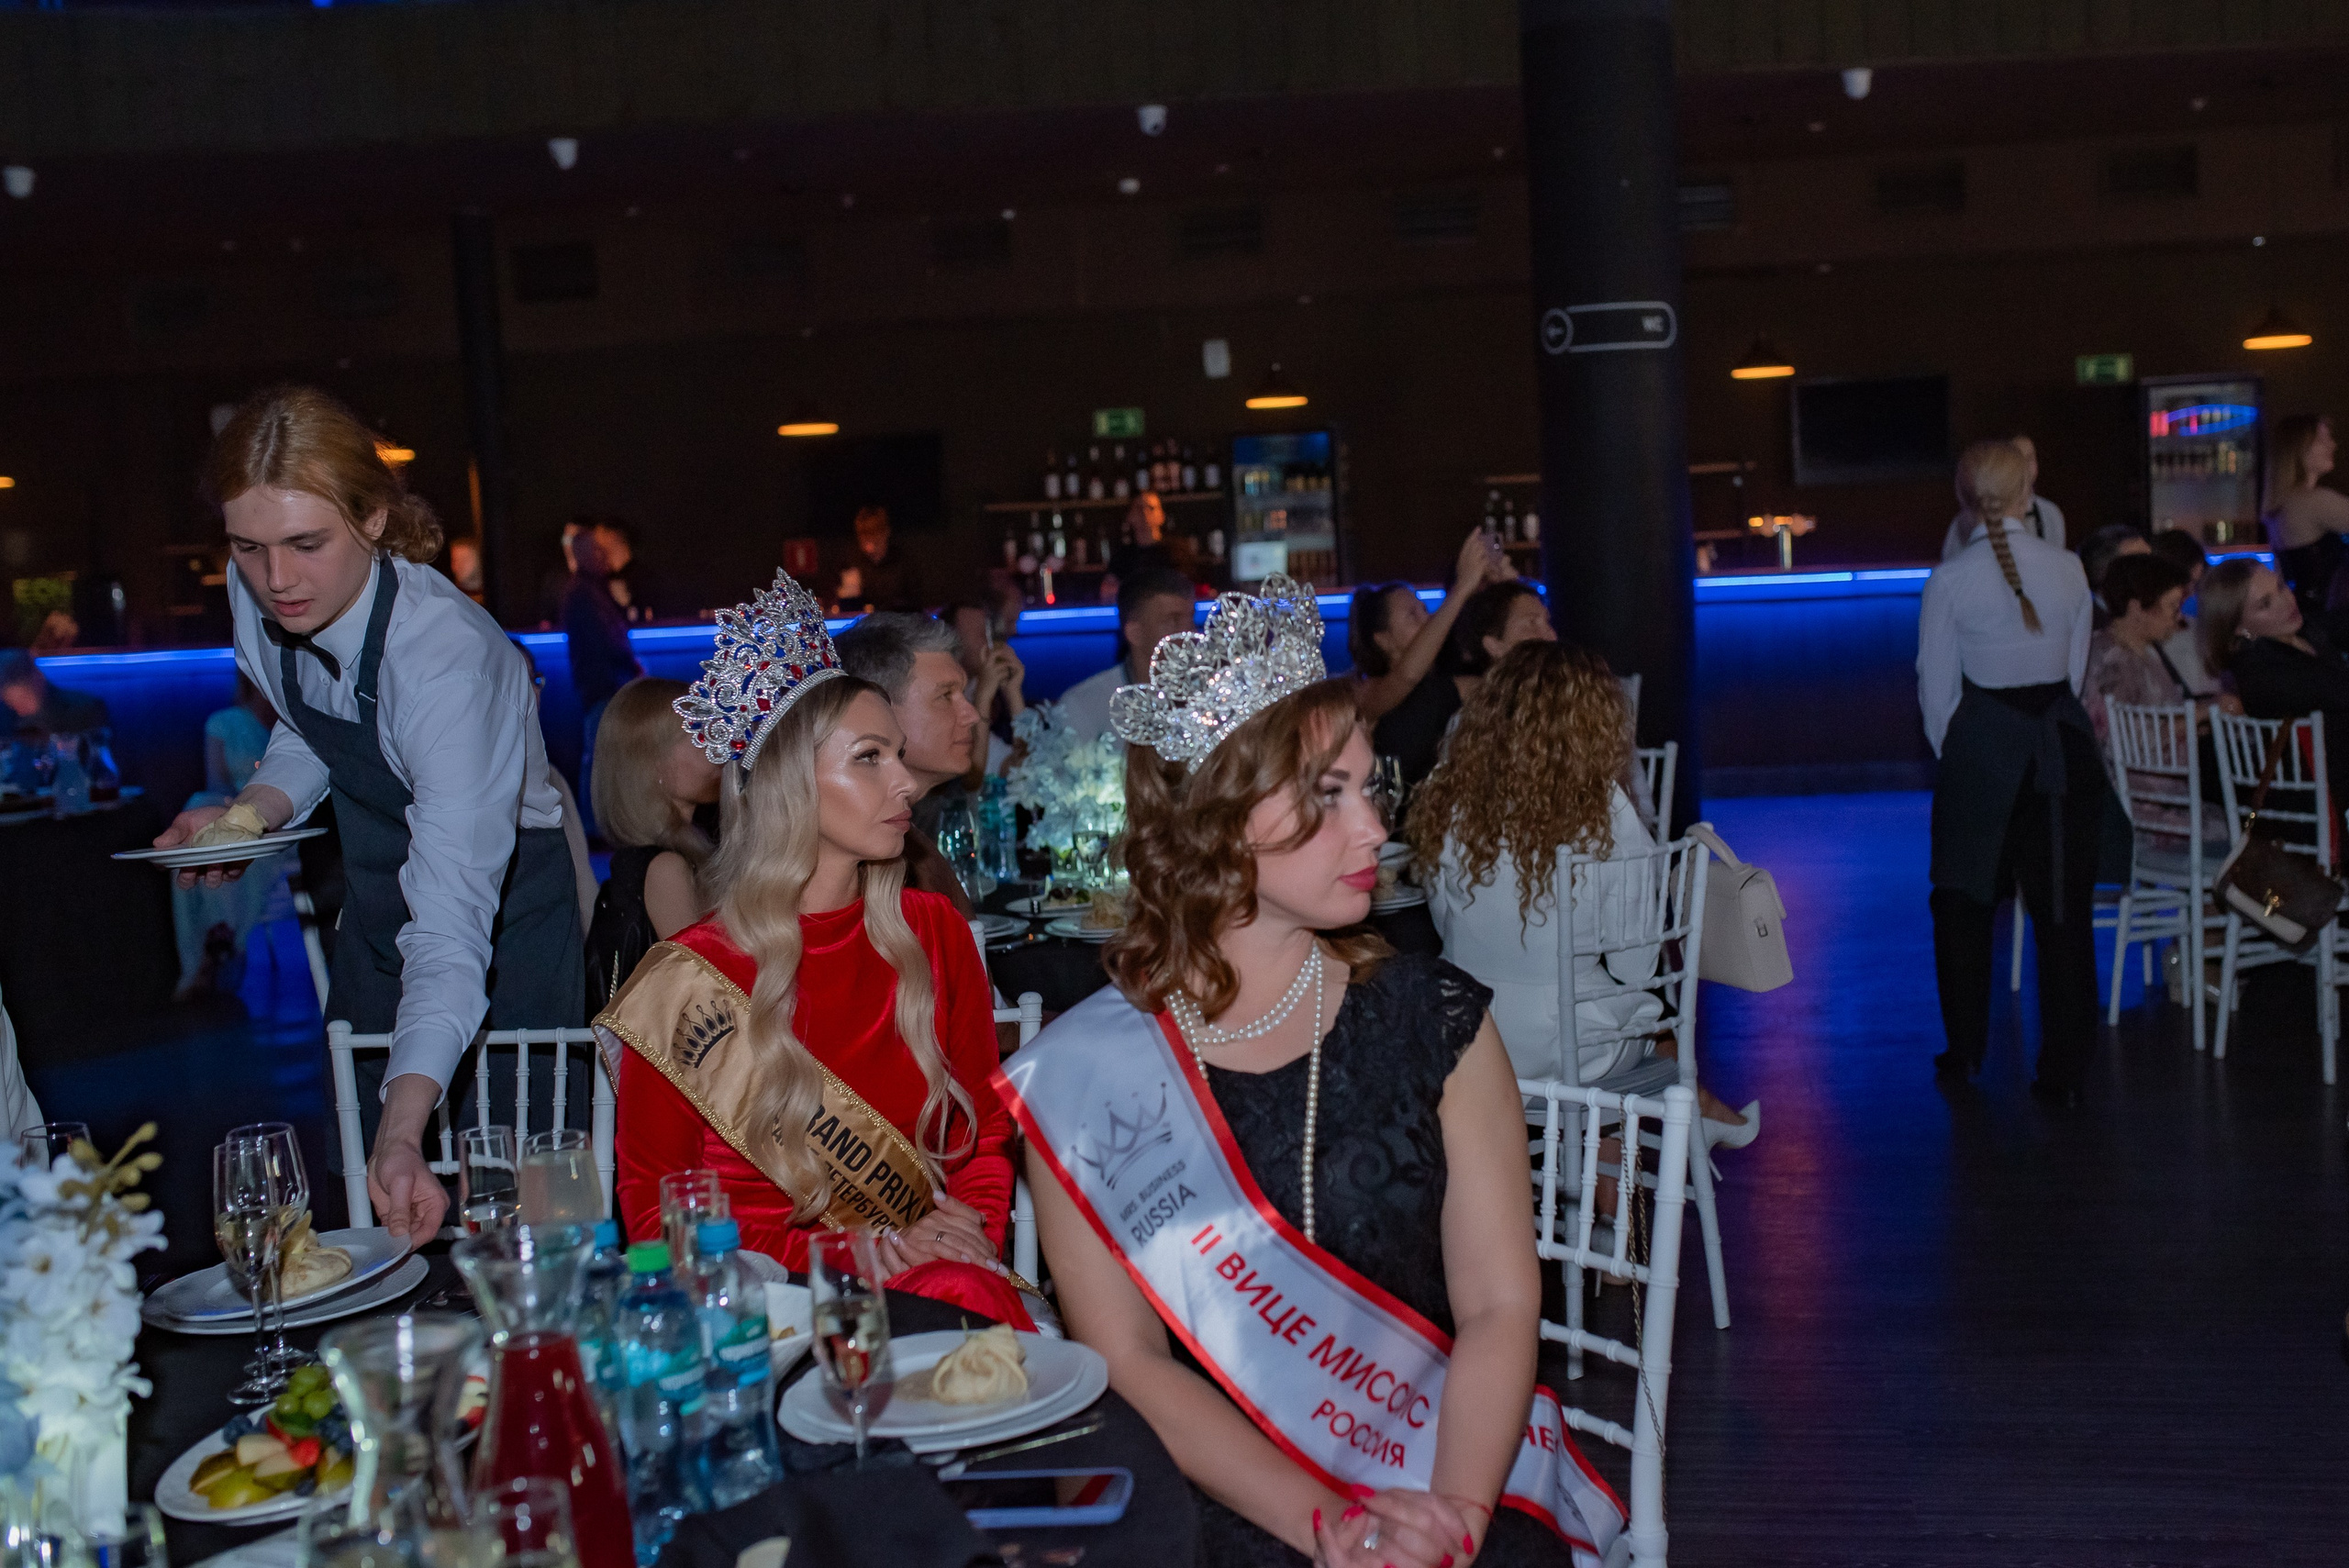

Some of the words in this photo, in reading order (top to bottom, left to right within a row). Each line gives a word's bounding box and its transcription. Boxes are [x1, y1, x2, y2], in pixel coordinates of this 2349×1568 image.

[807, 1105, 873, 1173] RAND
[864, 1160, 921, 1224] PRIX
[1130, 1184, 1197, 1248] RUSSIA
[1215, 1251, 1317, 1347] ВИЦЕ
[1310, 1398, 1406, 1469] РОССИЯ
